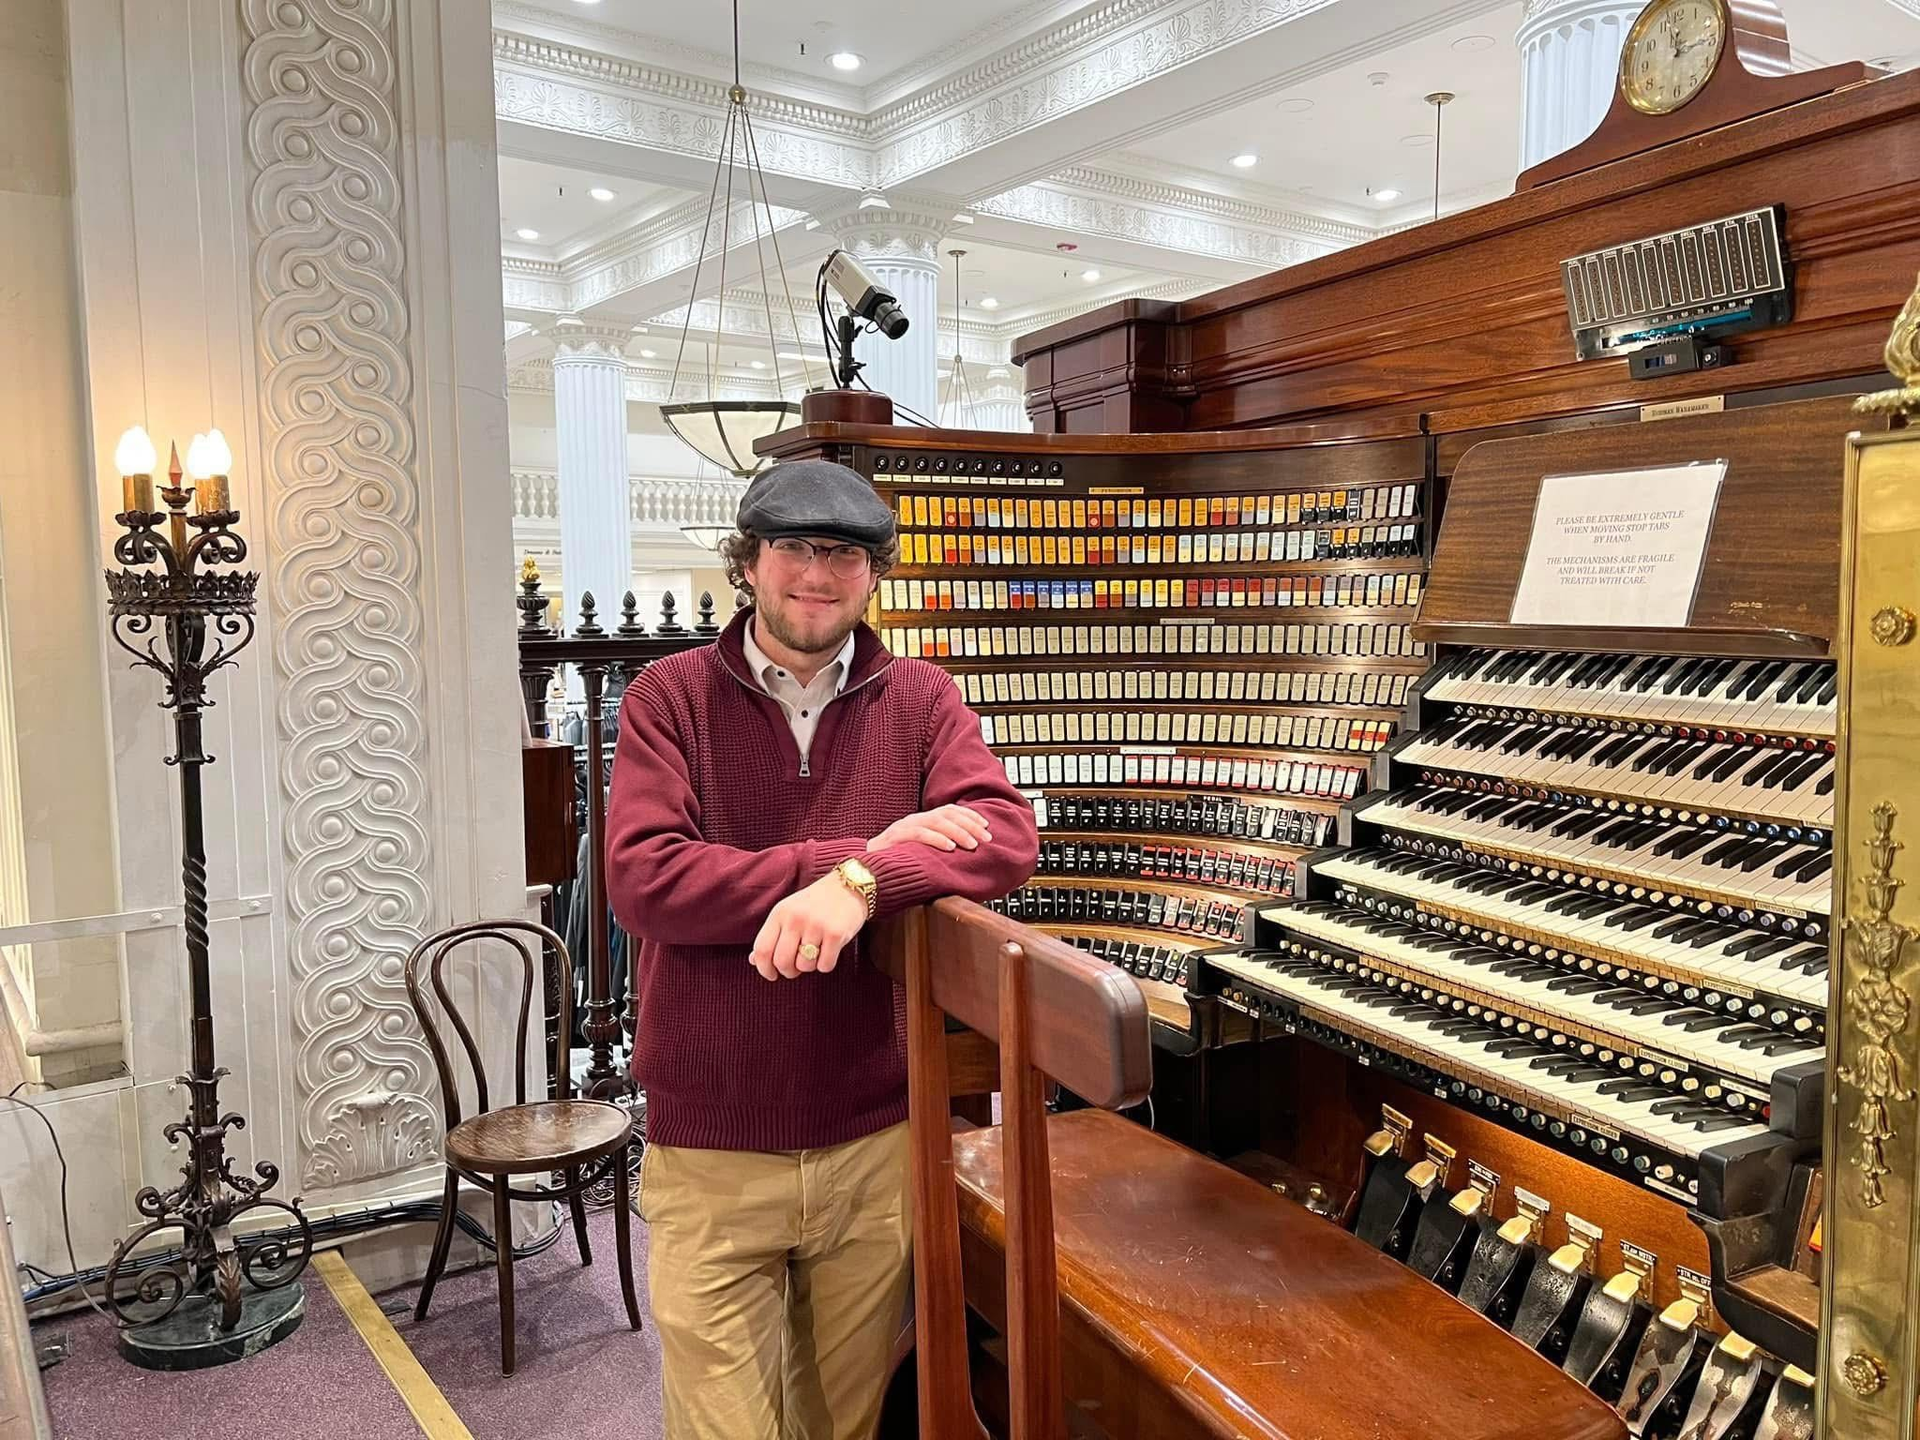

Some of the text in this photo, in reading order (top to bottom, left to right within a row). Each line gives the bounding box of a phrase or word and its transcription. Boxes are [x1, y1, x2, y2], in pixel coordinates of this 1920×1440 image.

[1674, 9, 1684, 23] 12
[1660, 21, 1667, 33] 11
[1646, 39, 1656, 53] 10
[1641, 61, 1649, 72] 9
[1646, 78, 1653, 90] 8
[1690, 74, 1697, 87] 5
[1673, 85, 1680, 98] 6
[1556, 510, 1684, 525] PLEASE BE EXTREMELY GENTLE
[1564, 522, 1670, 534] WHEN MOVING STOP TABS
[1594, 535, 1605, 543] BY
[1546, 554, 1675, 565] THE MECHANISMS ARE FRAGILE
[1557, 565, 1656, 575] AND WILL BREAK IF NOT
[1560, 576, 1648, 585] TREATED WITH CARE.
[1640, 1048, 1687, 1070] EXPRESSION CLOSED
[1573, 1115, 1599, 1131] EXPRESSION
